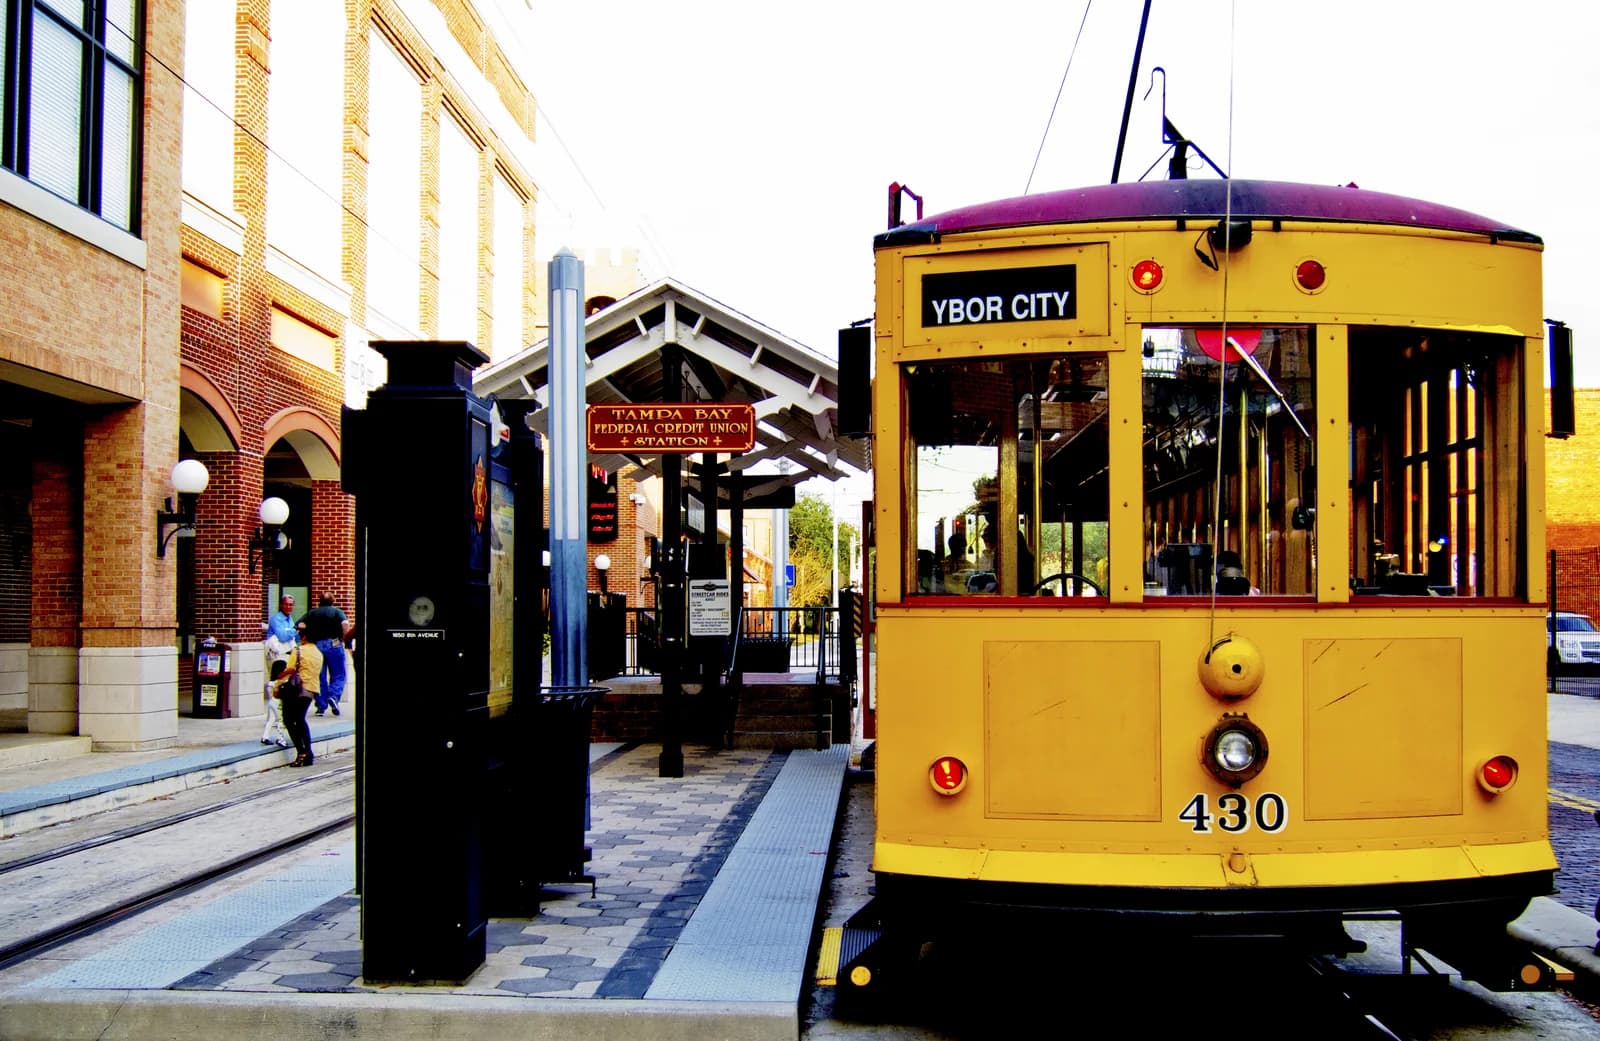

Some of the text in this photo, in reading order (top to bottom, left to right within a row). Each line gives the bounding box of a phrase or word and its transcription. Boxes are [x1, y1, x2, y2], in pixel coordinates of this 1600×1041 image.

[932, 291, 1069, 324] YBOR CITY
[612, 409, 733, 420] TAMPA BAY
[594, 423, 748, 434] FEDERAL CREDIT UNION
[633, 436, 709, 446] STATION
[1178, 791, 1289, 835] 430
